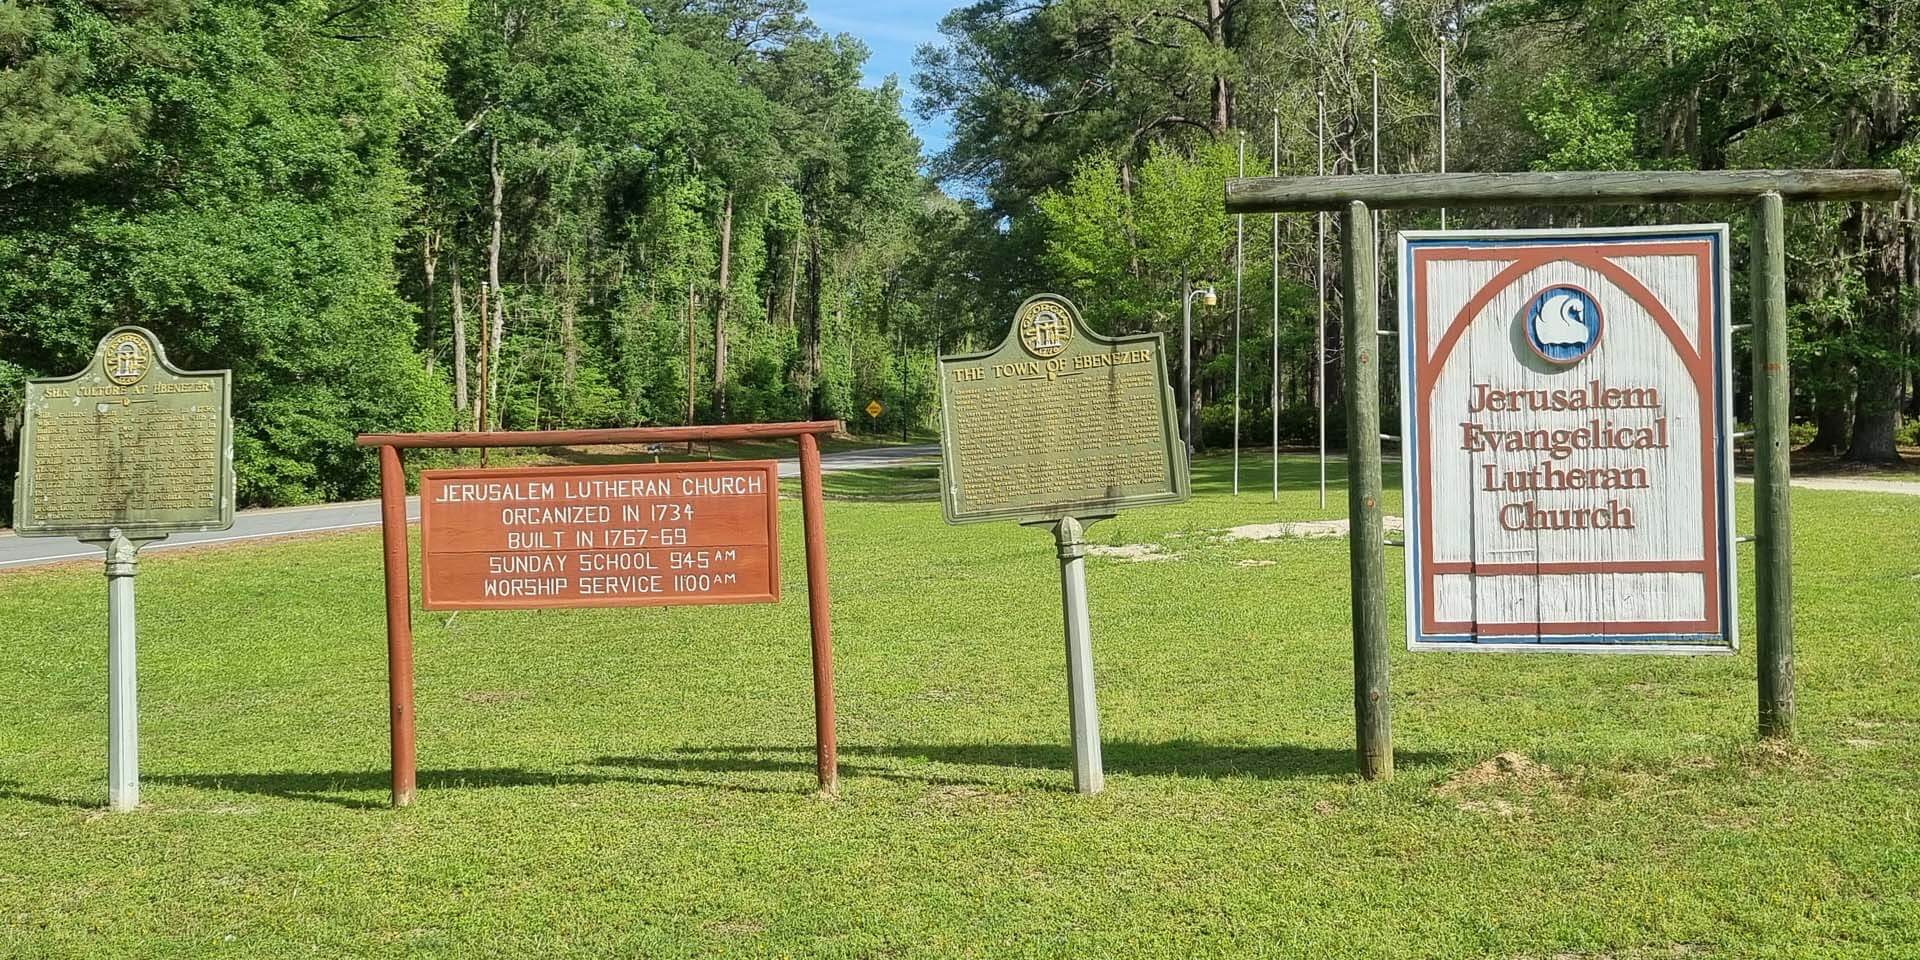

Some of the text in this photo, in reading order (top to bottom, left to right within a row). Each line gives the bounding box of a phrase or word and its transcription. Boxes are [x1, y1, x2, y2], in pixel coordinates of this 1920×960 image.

[952, 349, 1152, 382] THE TOWN OF EBENEZER
[76, 385, 128, 397] CULTURE
[132, 384, 149, 395] AT
[1469, 380, 1661, 413] Jerusalem
[1460, 416, 1669, 459] Evangelical
[436, 476, 762, 502] JERUSALEM LUTHERAN CHURCH
[1482, 461, 1650, 492] Lutheran
[502, 504, 695, 525] ORGANIZED IN 1734
[1500, 500, 1636, 531] Church
[508, 528, 687, 549] BUILT IN 1767-69
[489, 555, 568, 574] SUNDAY
[579, 553, 659, 572] SCHOOL
[715, 550, 736, 561] AM
[485, 577, 568, 597] WORSHIP
[579, 576, 663, 595] SERVICE
[713, 573, 736, 584] AM
